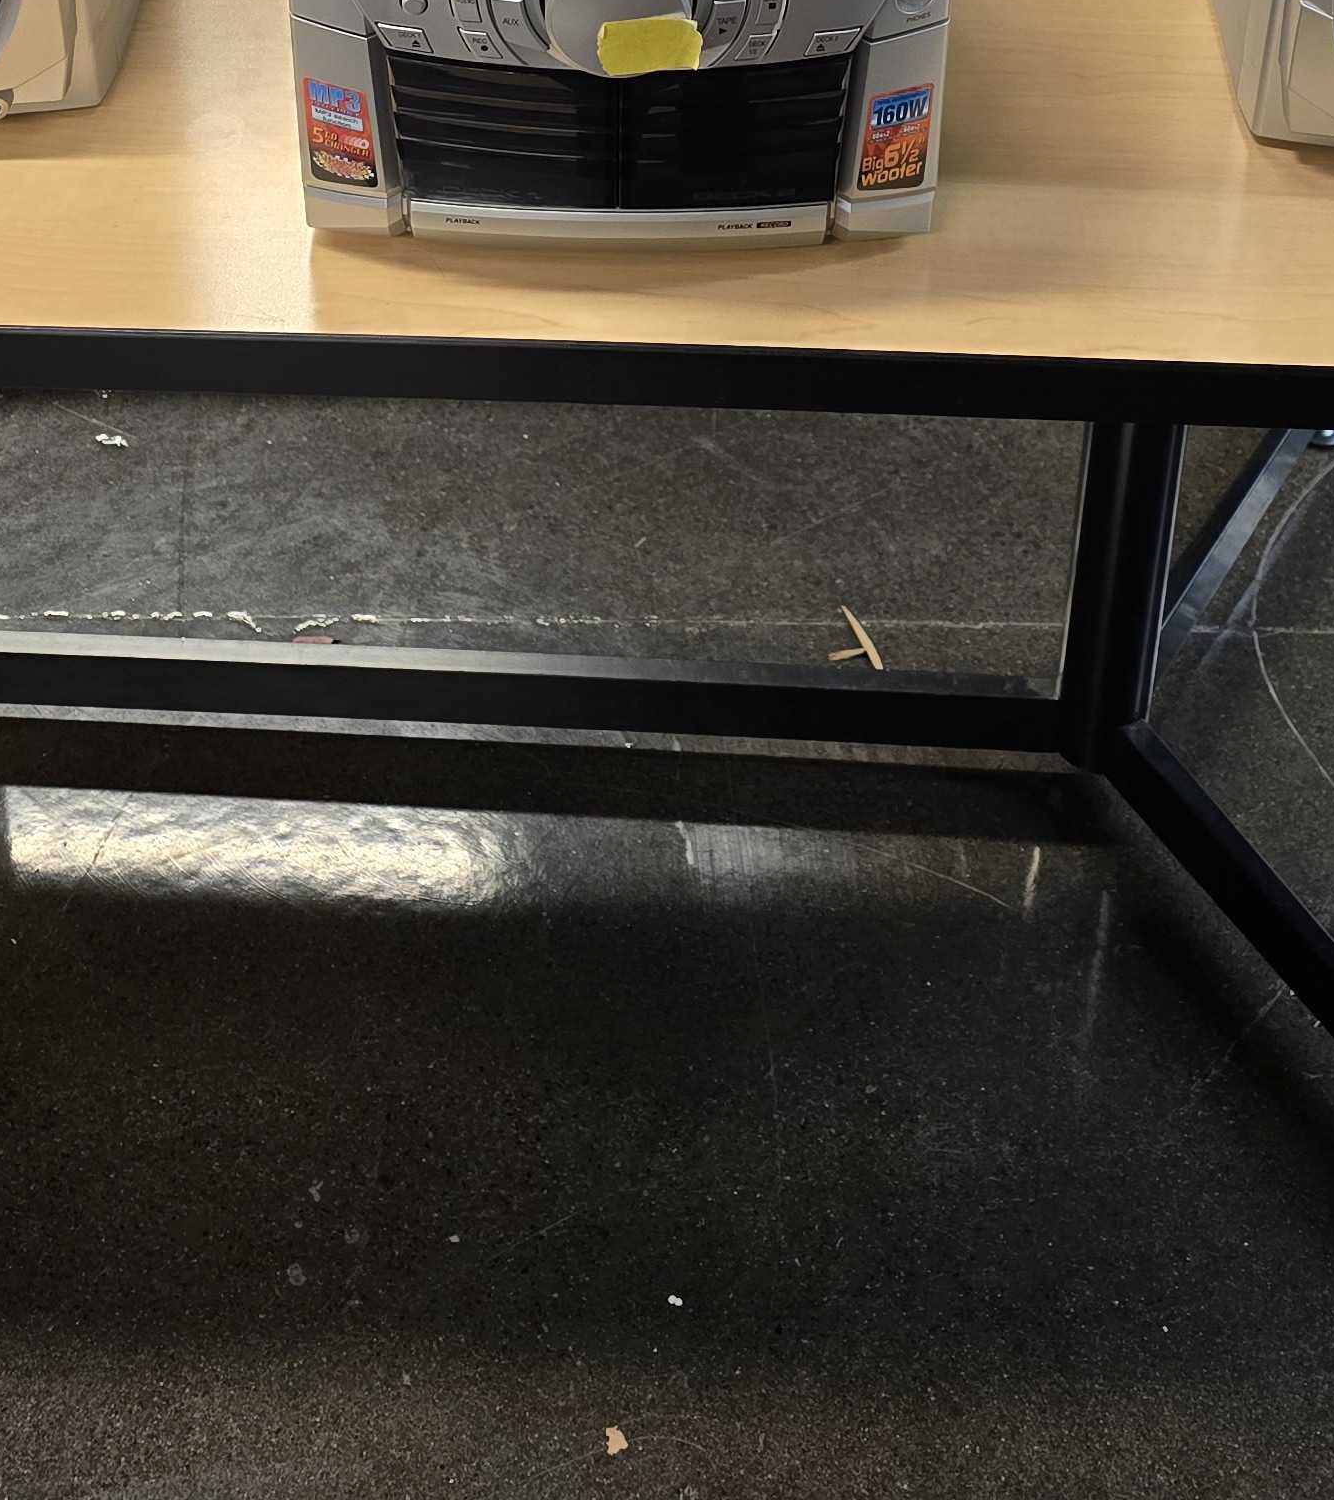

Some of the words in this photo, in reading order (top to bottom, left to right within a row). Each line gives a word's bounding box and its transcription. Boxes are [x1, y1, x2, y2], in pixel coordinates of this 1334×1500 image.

[309, 79, 361, 113] MP3
[873, 97, 927, 126] 160W
[312, 126, 325, 143] 5
[862, 157, 884, 172] Big
[445, 217, 481, 225] PLAYBACK
